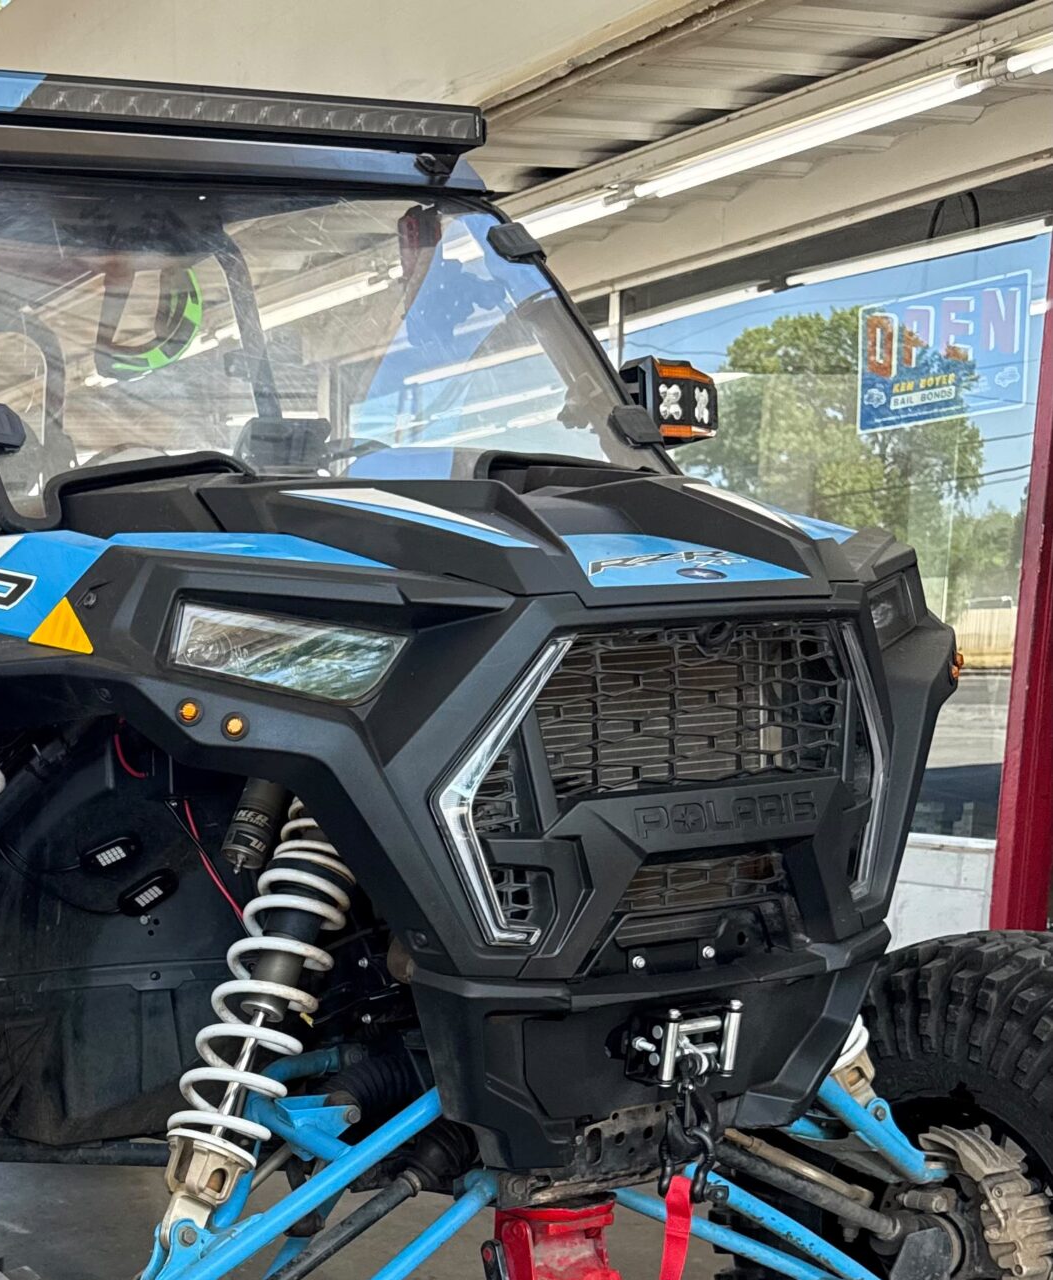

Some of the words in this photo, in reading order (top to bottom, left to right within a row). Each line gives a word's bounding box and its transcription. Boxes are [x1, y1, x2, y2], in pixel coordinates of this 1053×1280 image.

[866, 288, 1021, 379] OPEN
[920, 388, 953, 402] BONDS
[634, 791, 818, 839] POLARIS
